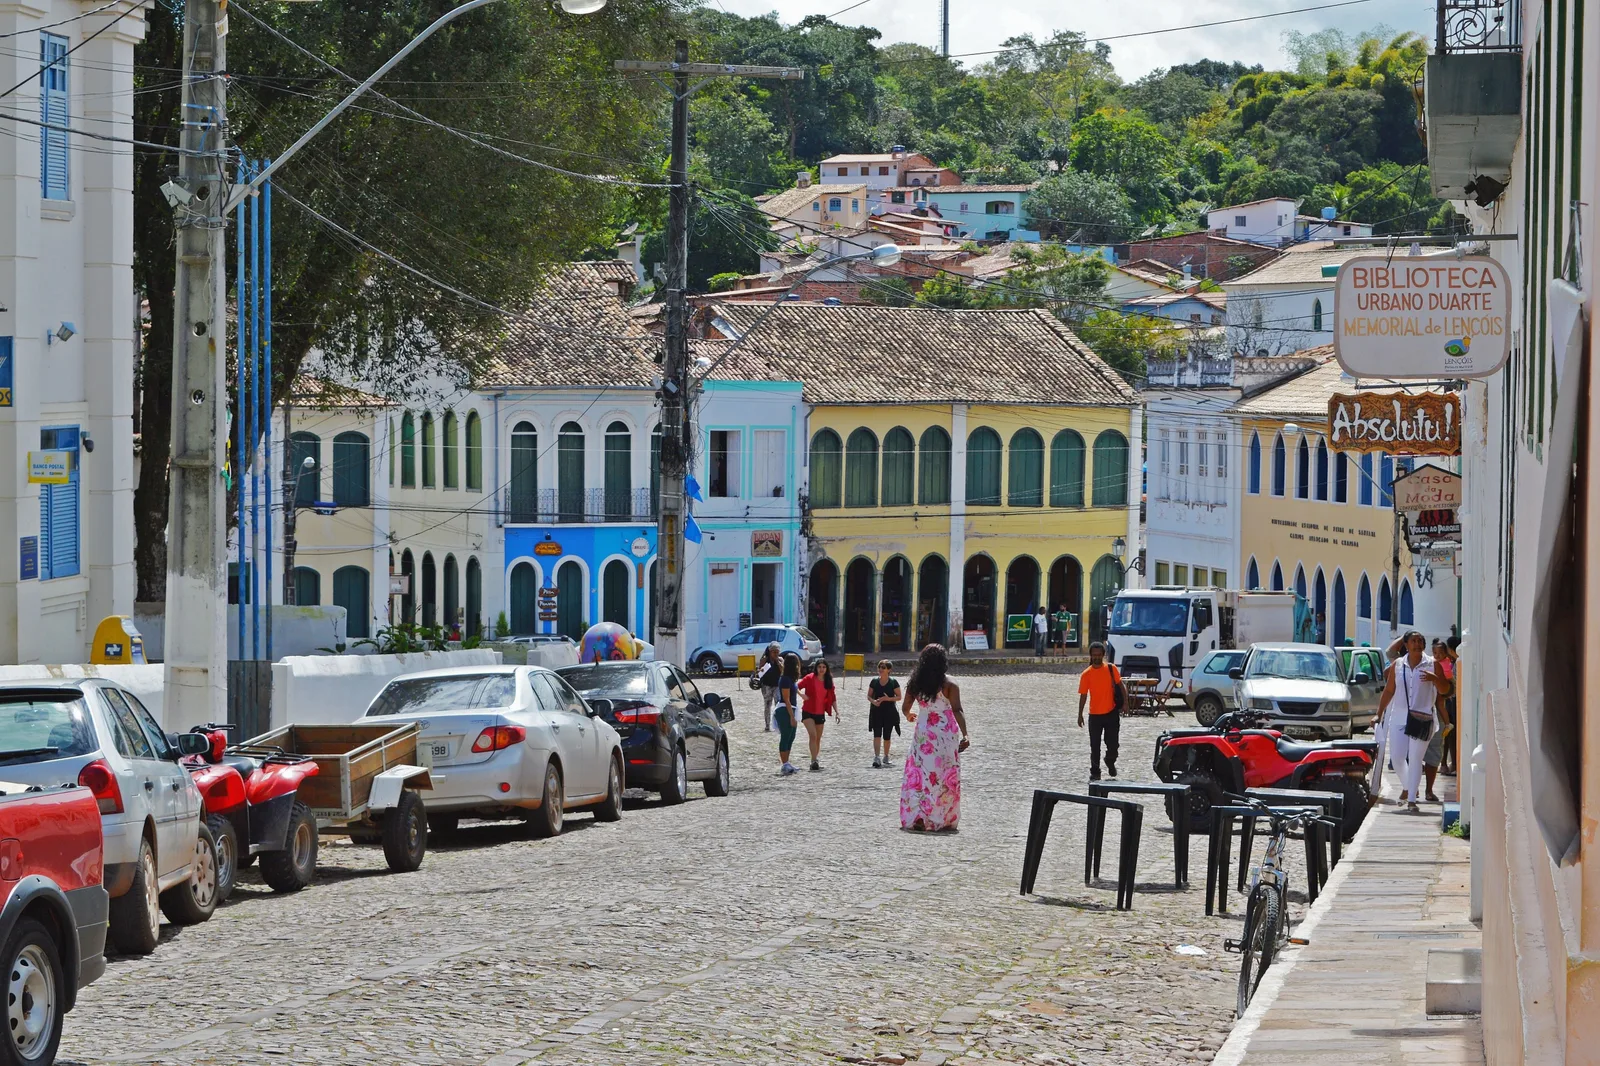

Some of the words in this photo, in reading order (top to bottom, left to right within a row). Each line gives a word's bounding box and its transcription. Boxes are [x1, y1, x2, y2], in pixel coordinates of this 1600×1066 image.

[1352, 267, 1498, 289] BIBLIOTECA
[1357, 292, 1424, 311] URBANO
[1428, 292, 1493, 311] DUARTE
[1343, 316, 1424, 336] MEMORIAL
[1424, 318, 1442, 334] de
[1444, 315, 1503, 337] LENÇÓIS
[1405, 488, 1456, 504] Moda
[1409, 526, 1429, 536] VOLTA
[1437, 524, 1460, 534] PARQUE
